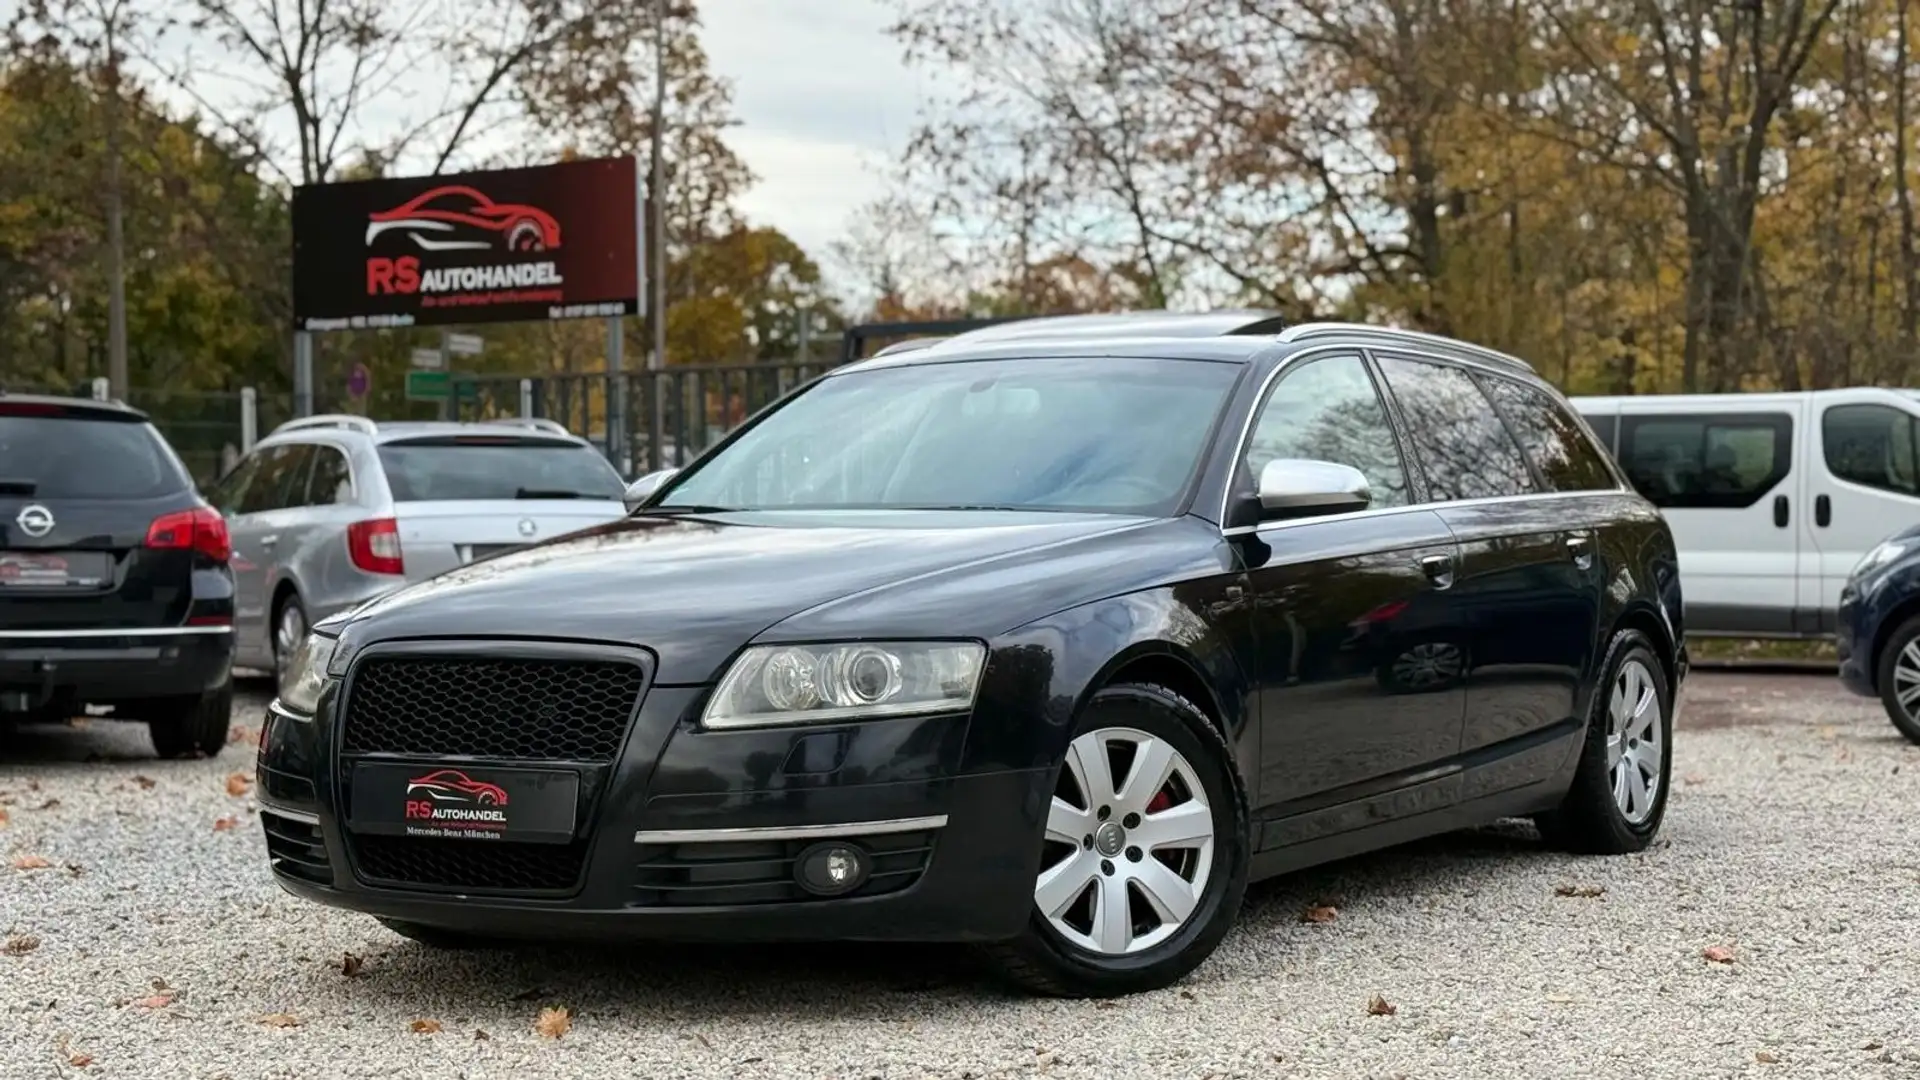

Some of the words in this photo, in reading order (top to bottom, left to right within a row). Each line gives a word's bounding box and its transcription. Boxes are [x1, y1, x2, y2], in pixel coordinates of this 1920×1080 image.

[366, 256, 420, 295] RS
[420, 262, 562, 292] AUTOHANDEL
[406, 801, 432, 818] RS
[432, 809, 506, 821] AUTOHANDEL
[406, 826, 462, 838] Mercedes-Benz
[464, 829, 501, 839] München
